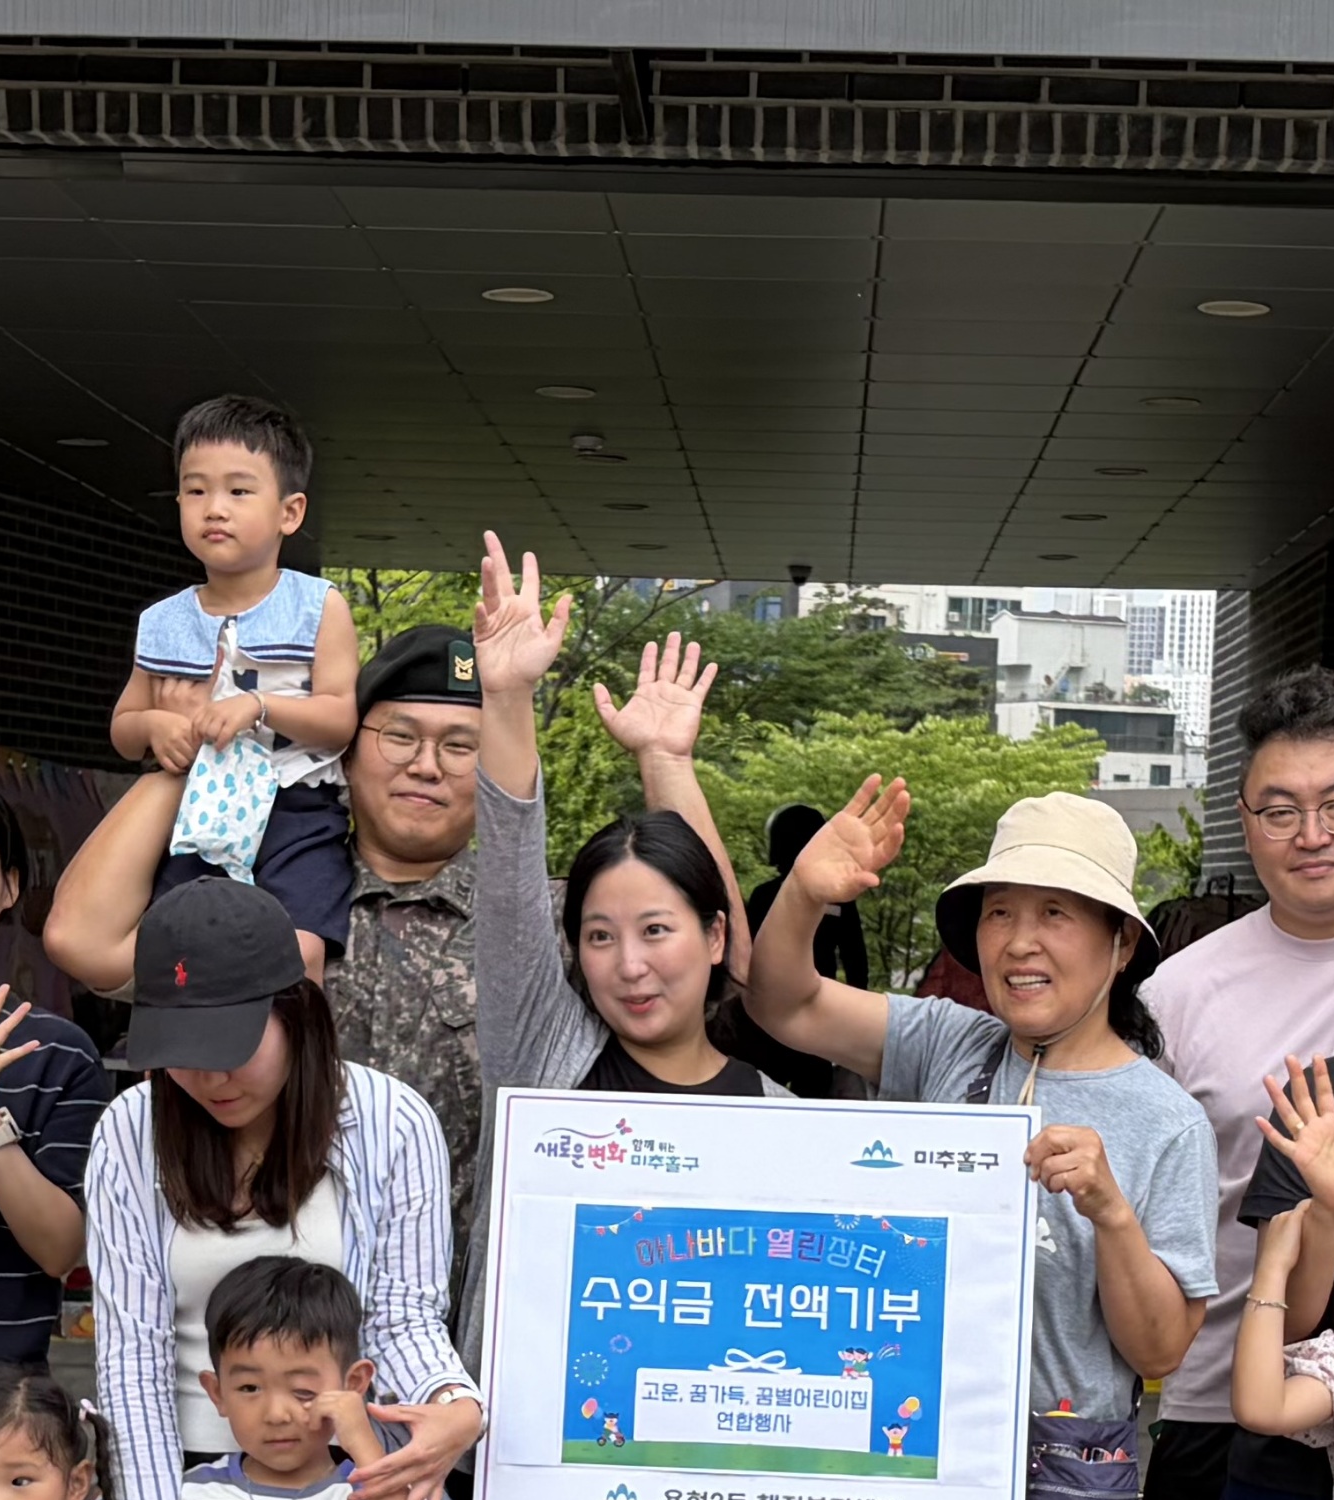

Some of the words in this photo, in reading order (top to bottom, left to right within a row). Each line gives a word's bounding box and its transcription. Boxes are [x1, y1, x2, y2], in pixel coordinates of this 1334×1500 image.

[534, 1135, 584, 1168] 새로운
[588, 1141, 627, 1169] 변화
[632, 1138, 654, 1152] 함께
[631, 1154, 699, 1173] 미추홀구
[913, 1149, 999, 1173] 미추홀구
[635, 1227, 757, 1267] 아나바다
[767, 1228, 886, 1278] 열린장터
[580, 1277, 713, 1325] 수익금
[744, 1283, 921, 1333] 전액기부
[641, 1382, 683, 1403] 고운,
[689, 1384, 749, 1405] 꿈가득,
[756, 1386, 868, 1410] 꿈별어린이집
[717, 1411, 792, 1433] 연합행사
